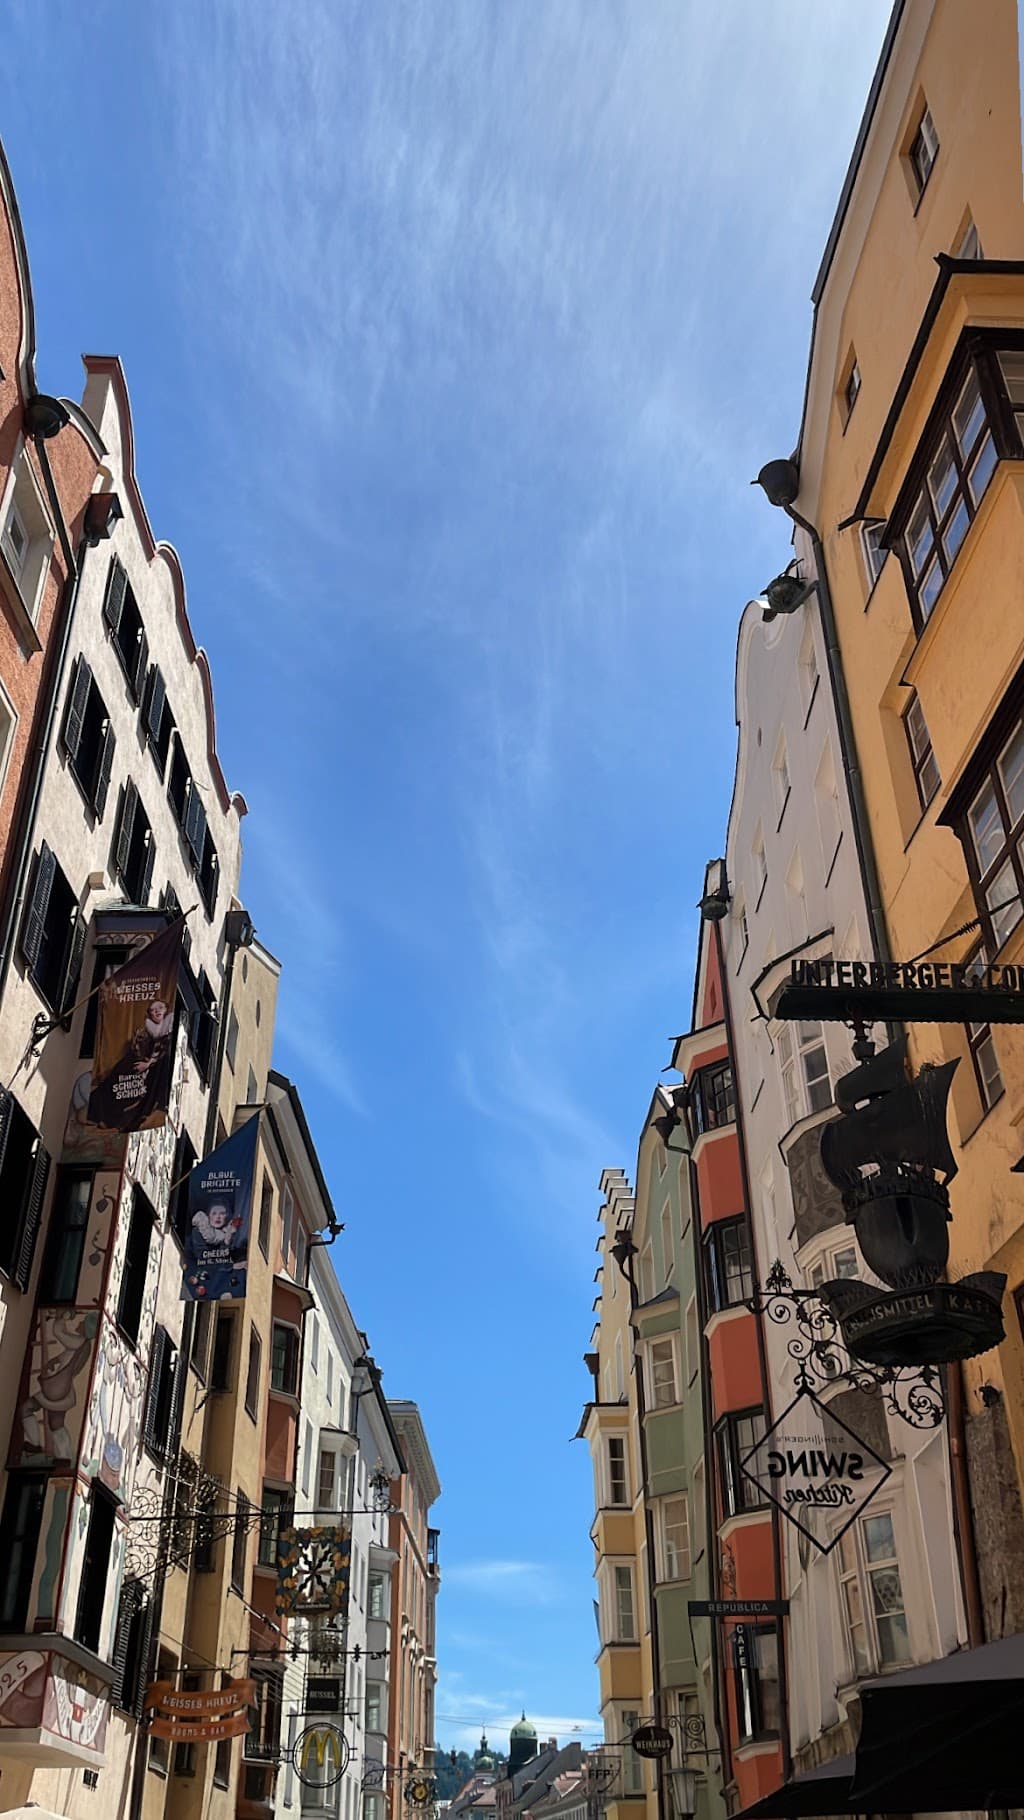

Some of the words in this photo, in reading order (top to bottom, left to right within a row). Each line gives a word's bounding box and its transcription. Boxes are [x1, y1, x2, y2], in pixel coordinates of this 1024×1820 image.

[791, 959, 967, 990] UNTERBERGER
[117, 982, 161, 994] WEISSES
[120, 992, 156, 1003] KREUZ
[208, 1171, 236, 1180] BLAUE
[200, 1179, 241, 1189] BRIGITTE
[202, 1248, 230, 1259] CHEERS
[707, 1602, 769, 1613] REPUBLICA
[162, 1695, 202, 1710] WEISSES
[206, 1693, 239, 1710] KREUZ
